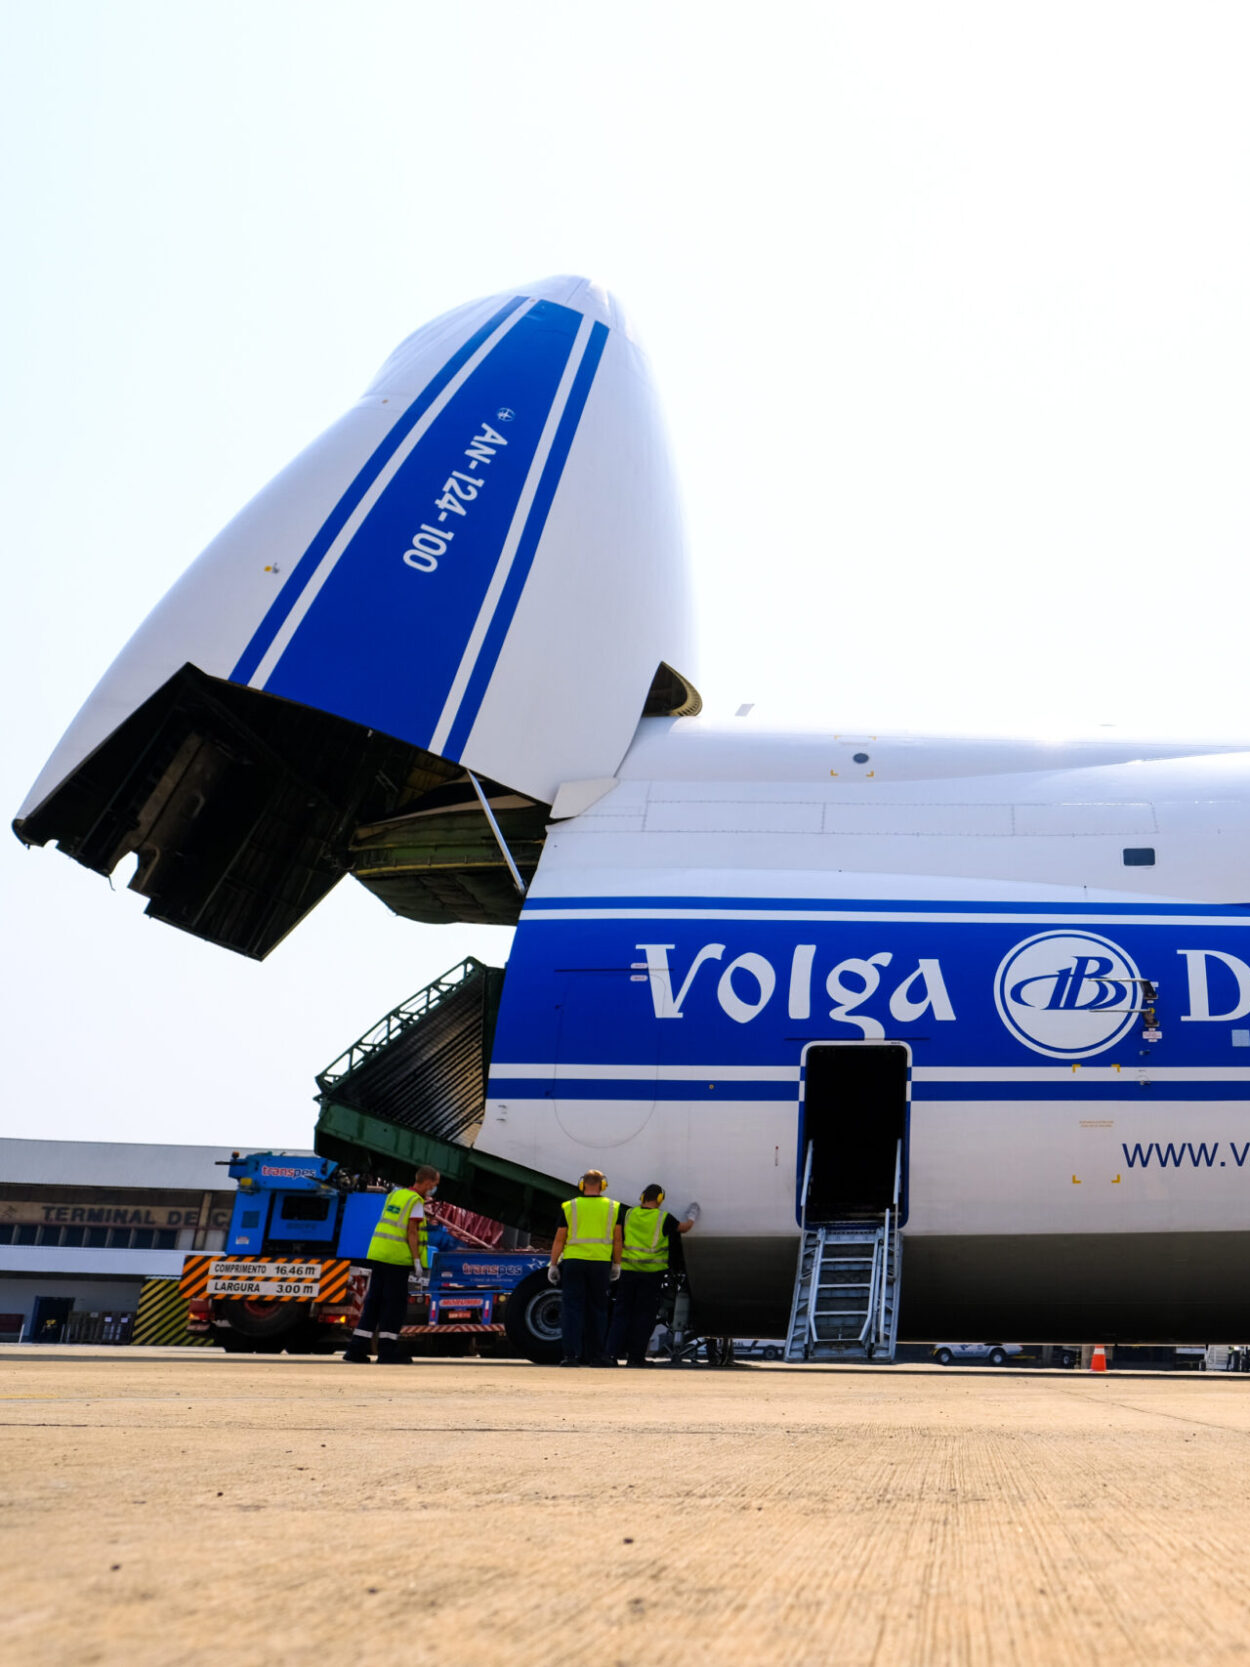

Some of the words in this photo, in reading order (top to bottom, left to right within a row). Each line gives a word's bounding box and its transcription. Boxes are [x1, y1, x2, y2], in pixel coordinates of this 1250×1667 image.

[403, 422, 508, 573] AN-124-100
[635, 943, 957, 1040] Volga
[262, 1165, 316, 1180] transpes
[41, 1205, 157, 1226] TERMINAL
[167, 1210, 198, 1226] DE
[214, 1263, 267, 1274] COMPRIMENTO
[305, 1266, 316, 1275] m
[462, 1262, 523, 1279] transpes
[214, 1282, 261, 1293] LARGURA
[303, 1285, 314, 1294] m
